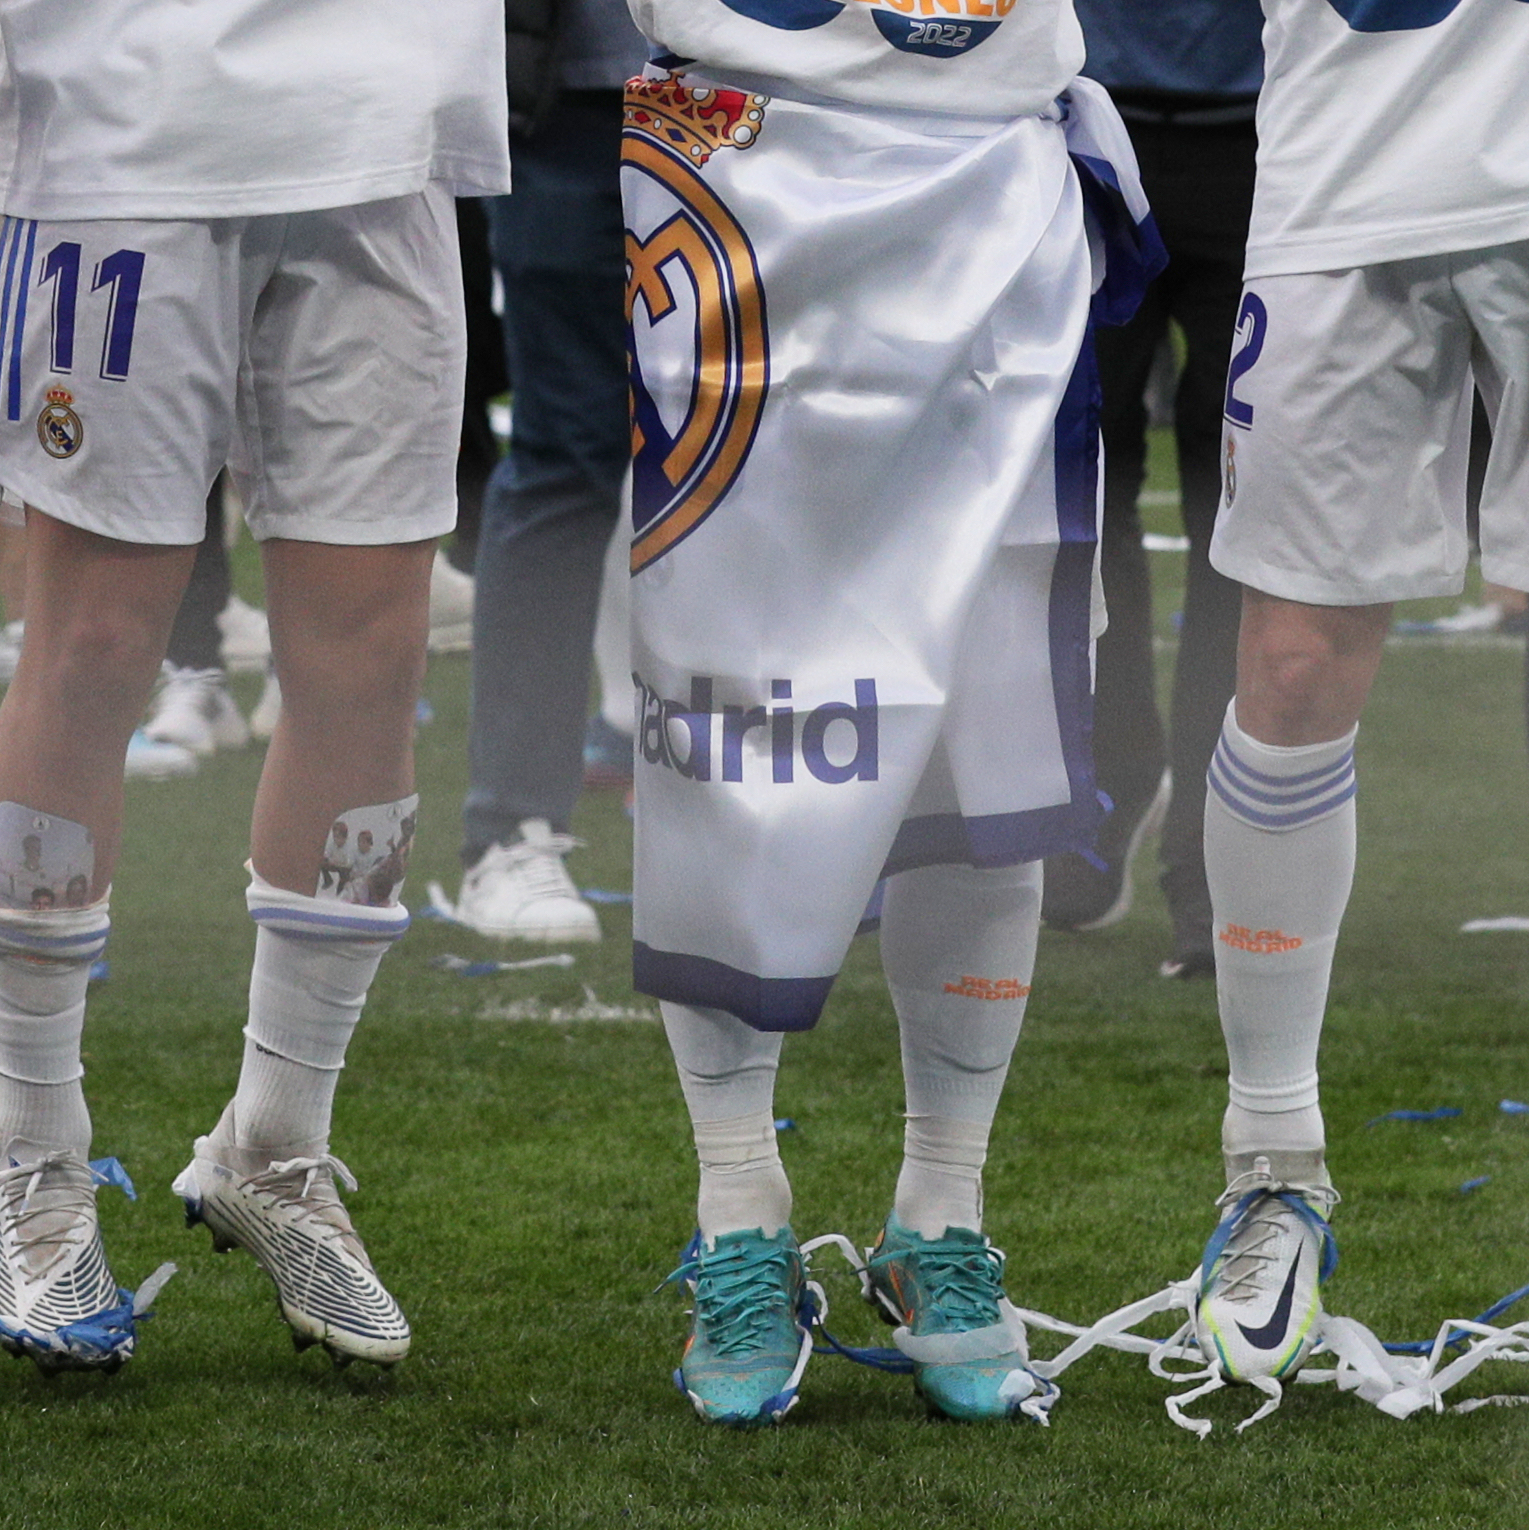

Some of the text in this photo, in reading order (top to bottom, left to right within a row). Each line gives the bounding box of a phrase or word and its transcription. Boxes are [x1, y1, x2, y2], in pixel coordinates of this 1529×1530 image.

[906, 21, 972, 48] 2022
[36, 240, 147, 382] 11
[961, 974, 1019, 990] REAL
